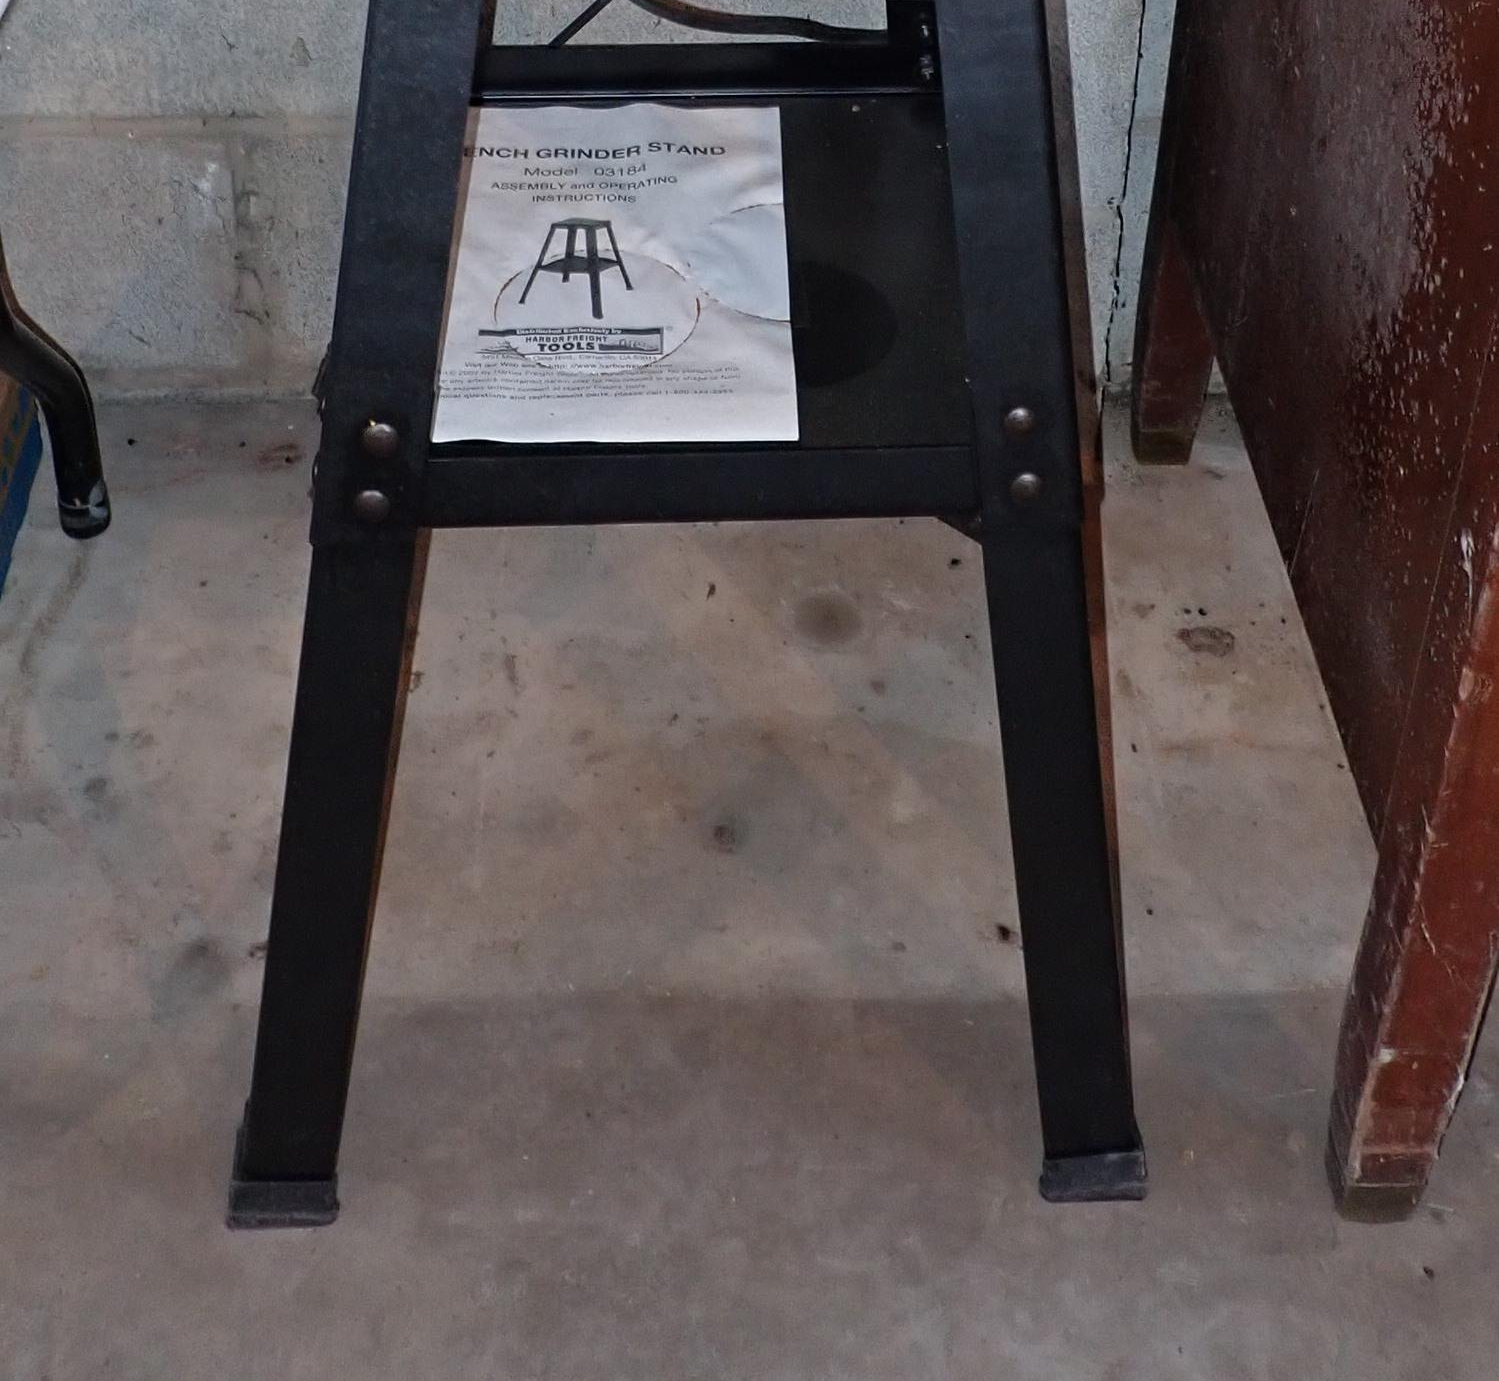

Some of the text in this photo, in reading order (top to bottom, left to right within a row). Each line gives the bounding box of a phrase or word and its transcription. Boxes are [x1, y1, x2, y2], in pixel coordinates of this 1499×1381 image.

[464, 142, 726, 160] ENCH GRINDER STAND
[523, 163, 648, 177] Model 03184
[490, 175, 678, 191] ASSEMBLY and OPERATING
[531, 193, 637, 204] INSTRUCTIONS
[537, 342, 596, 353] TOOLS
